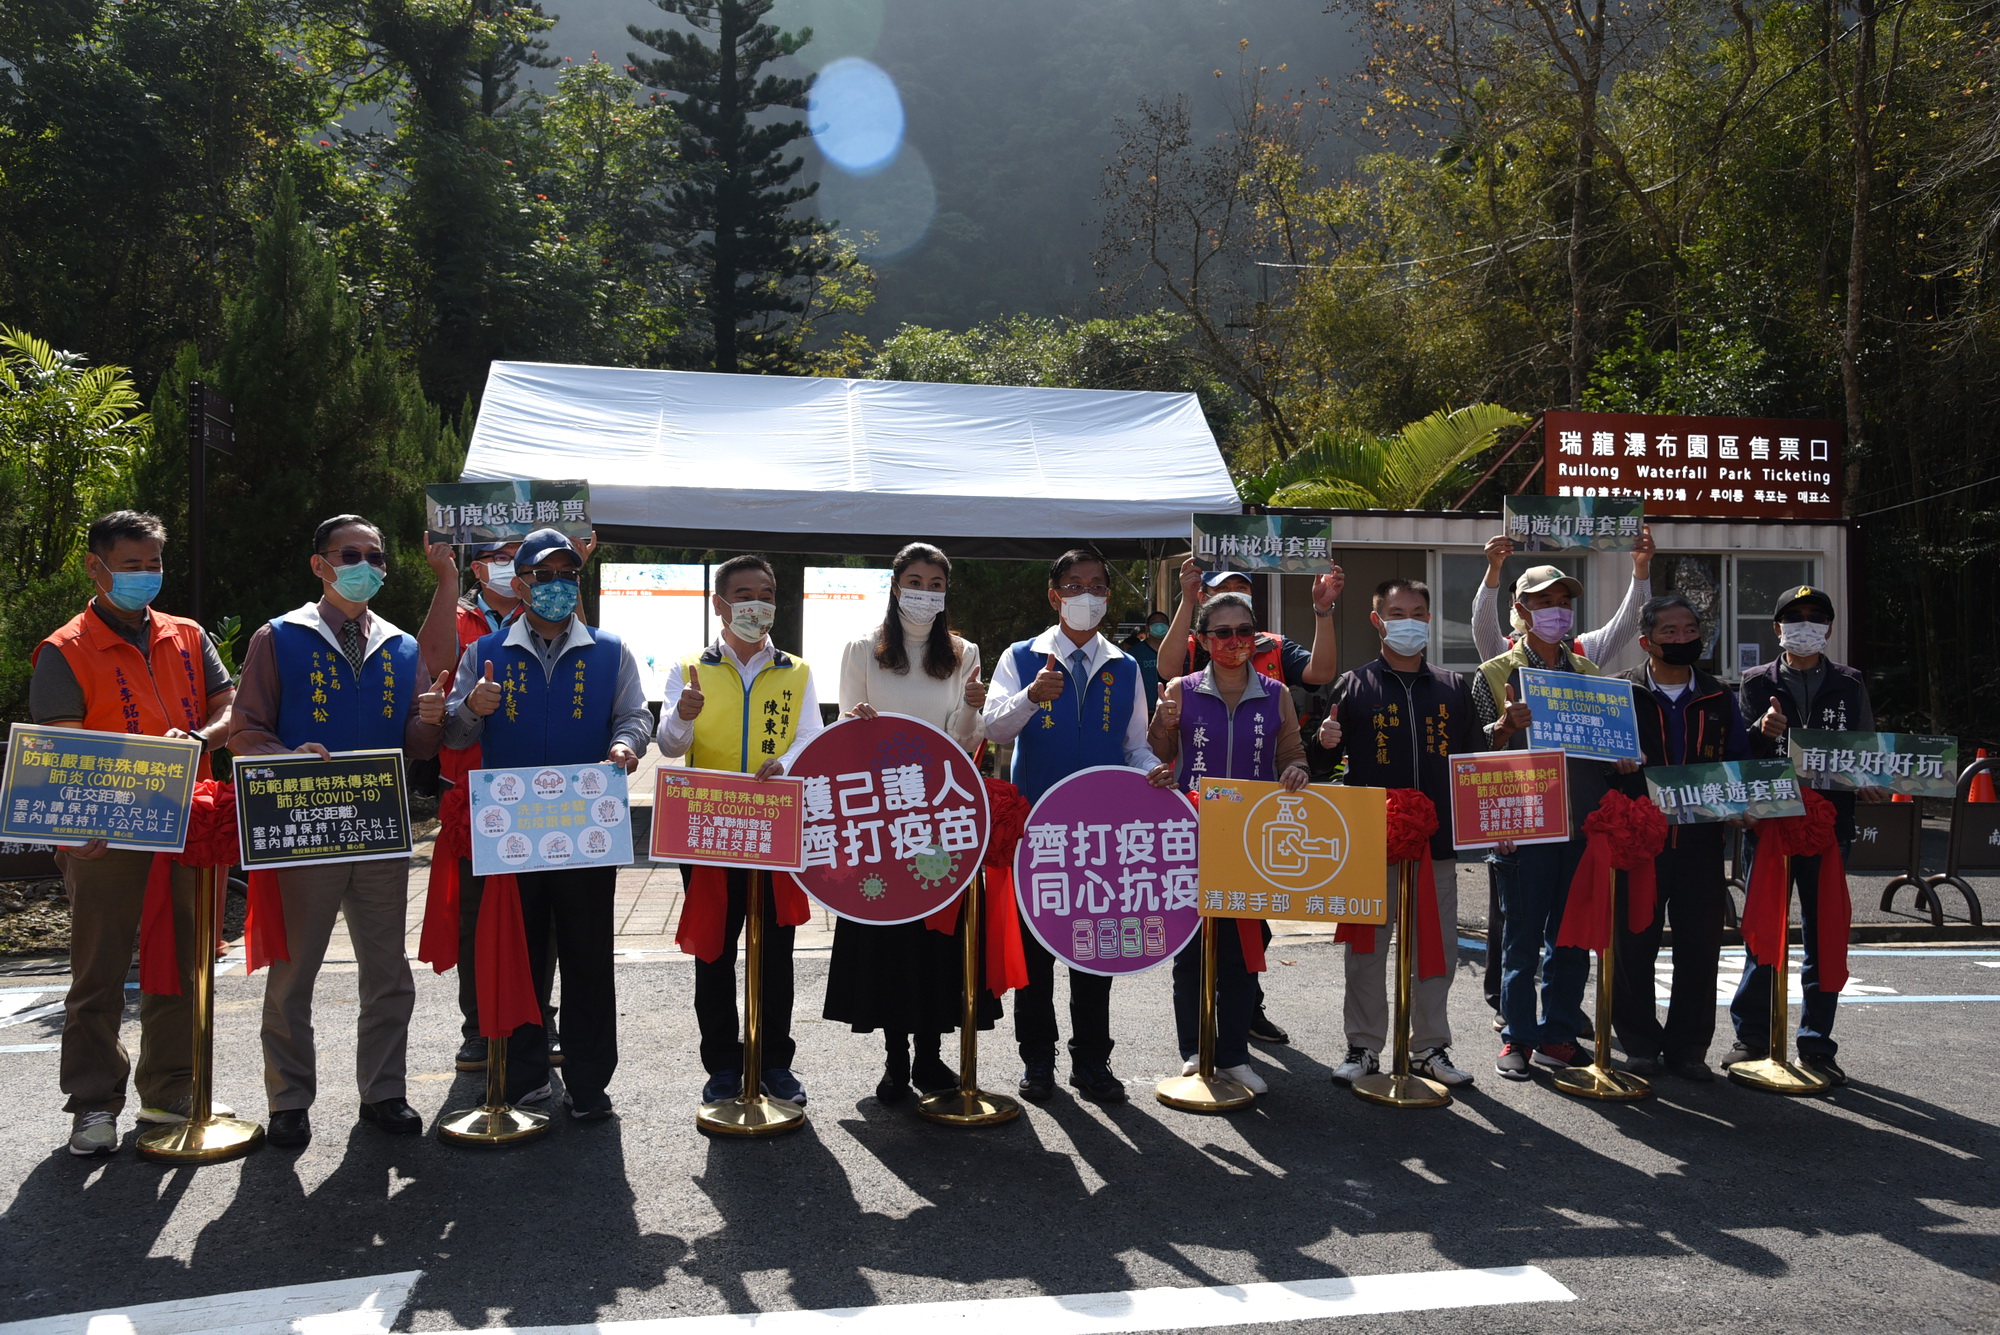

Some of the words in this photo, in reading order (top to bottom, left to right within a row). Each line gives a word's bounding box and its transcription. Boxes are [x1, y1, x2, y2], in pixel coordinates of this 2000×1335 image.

[1558, 431, 1828, 462] 瑞龍瀑布園區售票口
[1558, 462, 1619, 480] Ruilong
[1636, 464, 1707, 480] Waterfall
[1719, 466, 1751, 480] Park
[1762, 468, 1831, 485] Ticketing
[1754, 490, 1788, 503] 폭포는
[1798, 491, 1830, 504] 매표소
[434, 499, 586, 528] 竹鹿悠遊聯票
[1510, 514, 1639, 537] 暢遊竹鹿套票
[1198, 534, 1328, 558] 山林祕境套票
[326, 652, 341, 690] 衛生局
[381, 648, 396, 719] 南投縣政府
[572, 659, 586, 720] 南投縣政府
[1528, 684, 1630, 708] 防範嚴重特殊傳染性
[780, 689, 792, 740] 竹山鎮長
[1387, 702, 1400, 728] 特助
[1557, 712, 1604, 728] (社交距離)
[761, 699, 780, 755] 陳東睦
[1372, 712, 1391, 765] 陳金龍
[1437, 703, 1450, 758] 馬文君
[1253, 712, 1266, 778] 南投縣議員
[22, 750, 184, 780] 防範嚴重特殊傳染性
[1802, 747, 1944, 779] 南投好好玩
[48, 769, 166, 793] 肺炎(COVID-19)
[249, 772, 394, 796] 防範嚴重特殊傳染性
[1459, 768, 1558, 786] 防範嚴重特殊傳染性
[60, 786, 136, 806] (社交距離)
[276, 788, 381, 809] 肺炎(COVID-19)
[666, 784, 794, 808] 防範嚴重特殊傳染性
[1478, 794, 1544, 810] 出入實聯制登記
[1656, 778, 1797, 808] 竹山樂遊套票
[14, 798, 176, 822] 室外請保持1公尺以上
[290, 804, 358, 823] (社交距離)
[518, 800, 586, 816] 洗手七步驟
[688, 800, 780, 820] 肺炎(COVID-19)
[1480, 806, 1544, 821] 定期清消環境
[252, 817, 398, 838] 室外請保持1公尺以上
[518, 814, 587, 830] 防疫跟著做
[688, 814, 772, 832] 出入實聯制登記
[688, 825, 772, 842] 定期清消環境
[1480, 817, 1544, 832] 保持社交距離
[686, 836, 772, 854] 保持社交距離
[802, 805, 979, 870] 齊打疫苗
[1028, 818, 1198, 870] 齊打疫苗
[1031, 864, 1198, 918] 同心抗疫
[1204, 889, 1291, 913] 清潔手部
[1305, 894, 1384, 917] 病毒OUT
